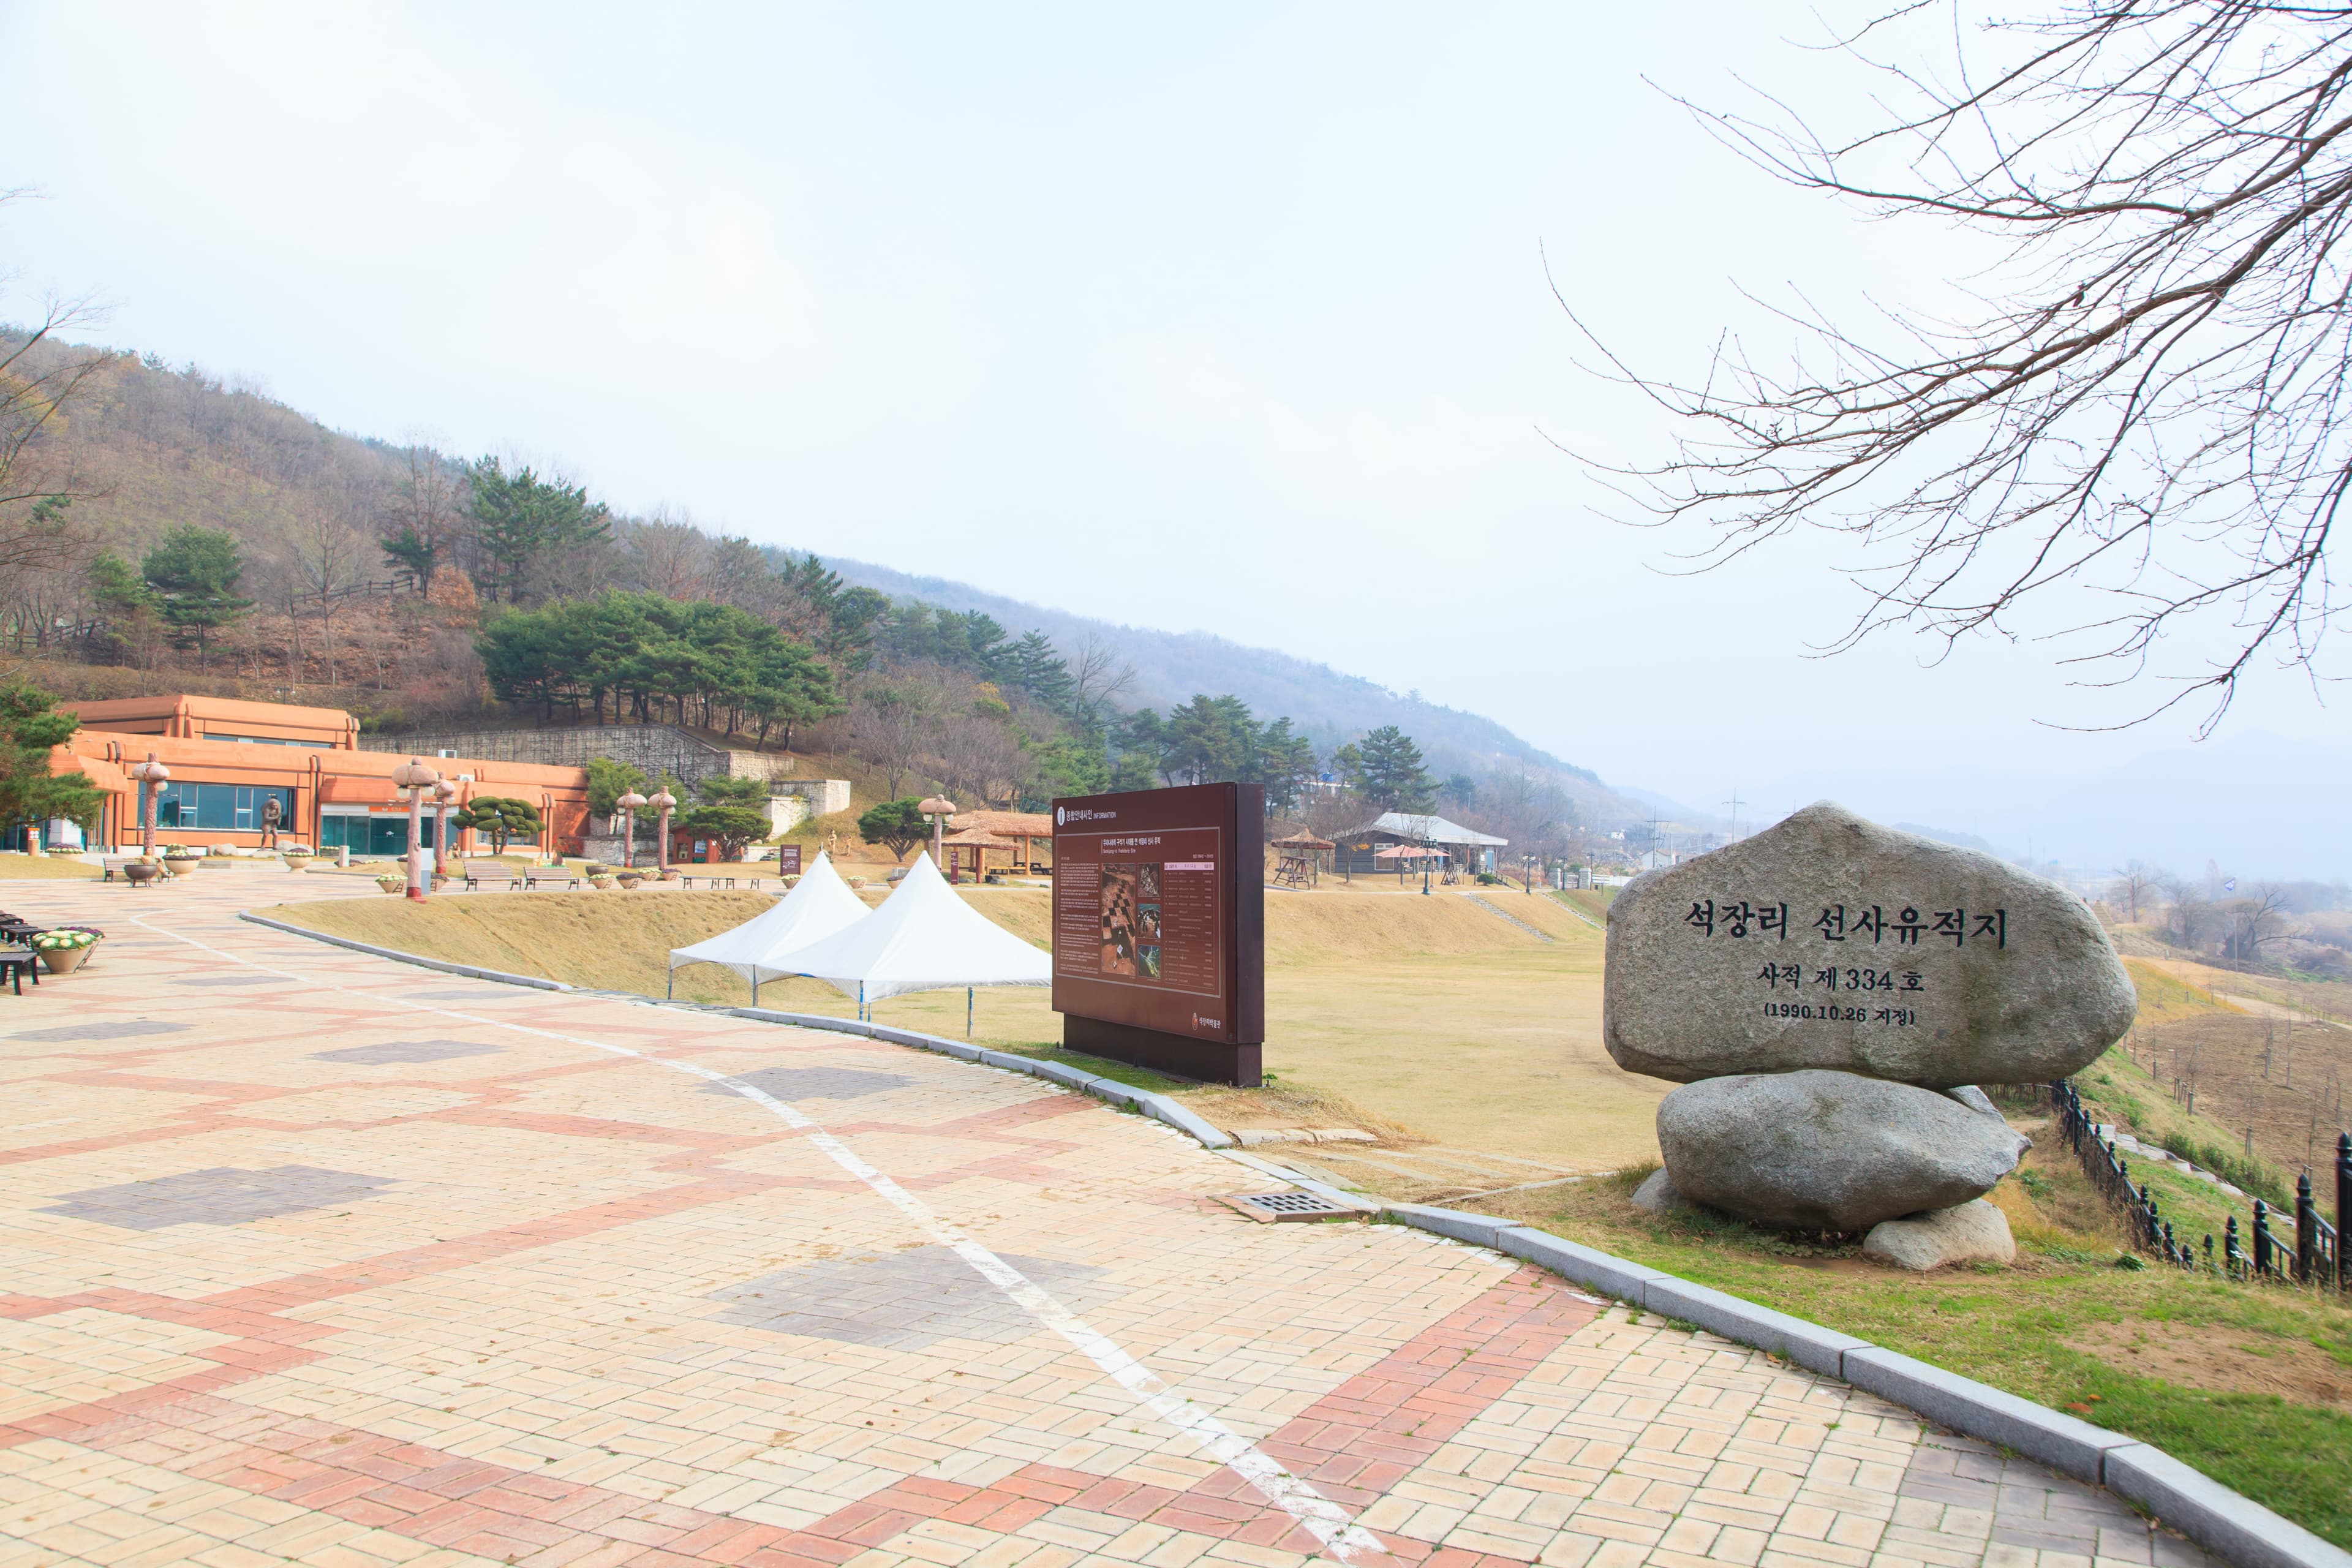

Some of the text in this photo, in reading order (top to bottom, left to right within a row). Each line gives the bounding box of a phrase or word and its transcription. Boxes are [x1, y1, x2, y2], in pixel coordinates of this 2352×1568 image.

[1066, 809, 1093, 821] 종합안내사인
[1684, 899, 2006, 950] 석장리 선사유적지
[1757, 962, 1801, 990] 사적
[1199, 1017, 1221, 1029] 석장리박물관
[1764, 1002, 1915, 1027] (1990.10.26 지정)
